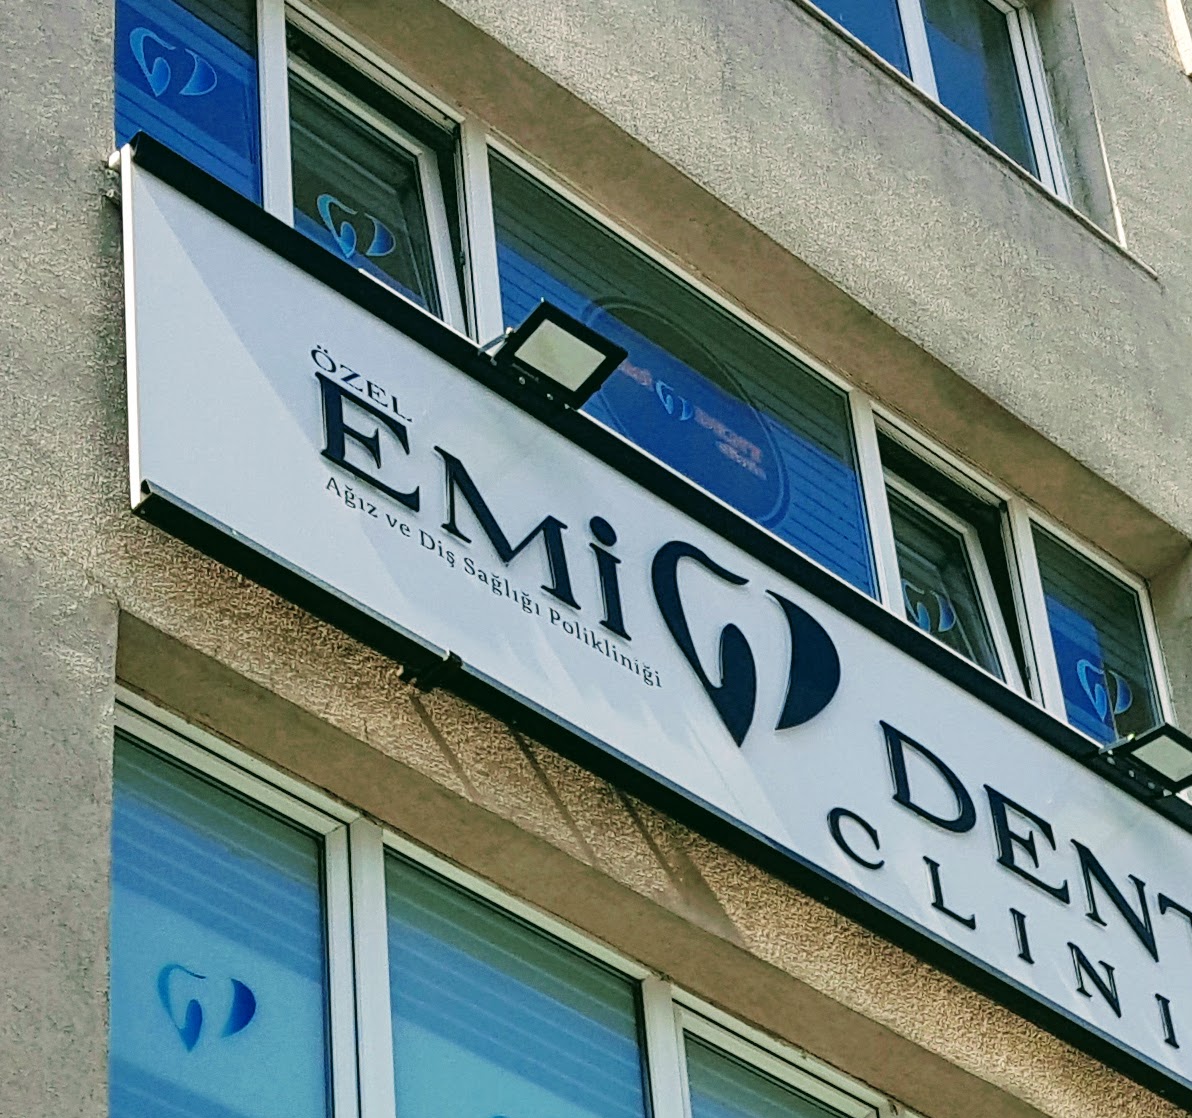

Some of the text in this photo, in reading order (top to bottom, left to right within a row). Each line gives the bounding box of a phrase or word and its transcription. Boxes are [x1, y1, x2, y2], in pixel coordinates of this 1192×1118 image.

[311, 345, 412, 421] ÖZEL
[326, 477, 663, 688] Ağız ve Diş Sağlığı Polikliniği
